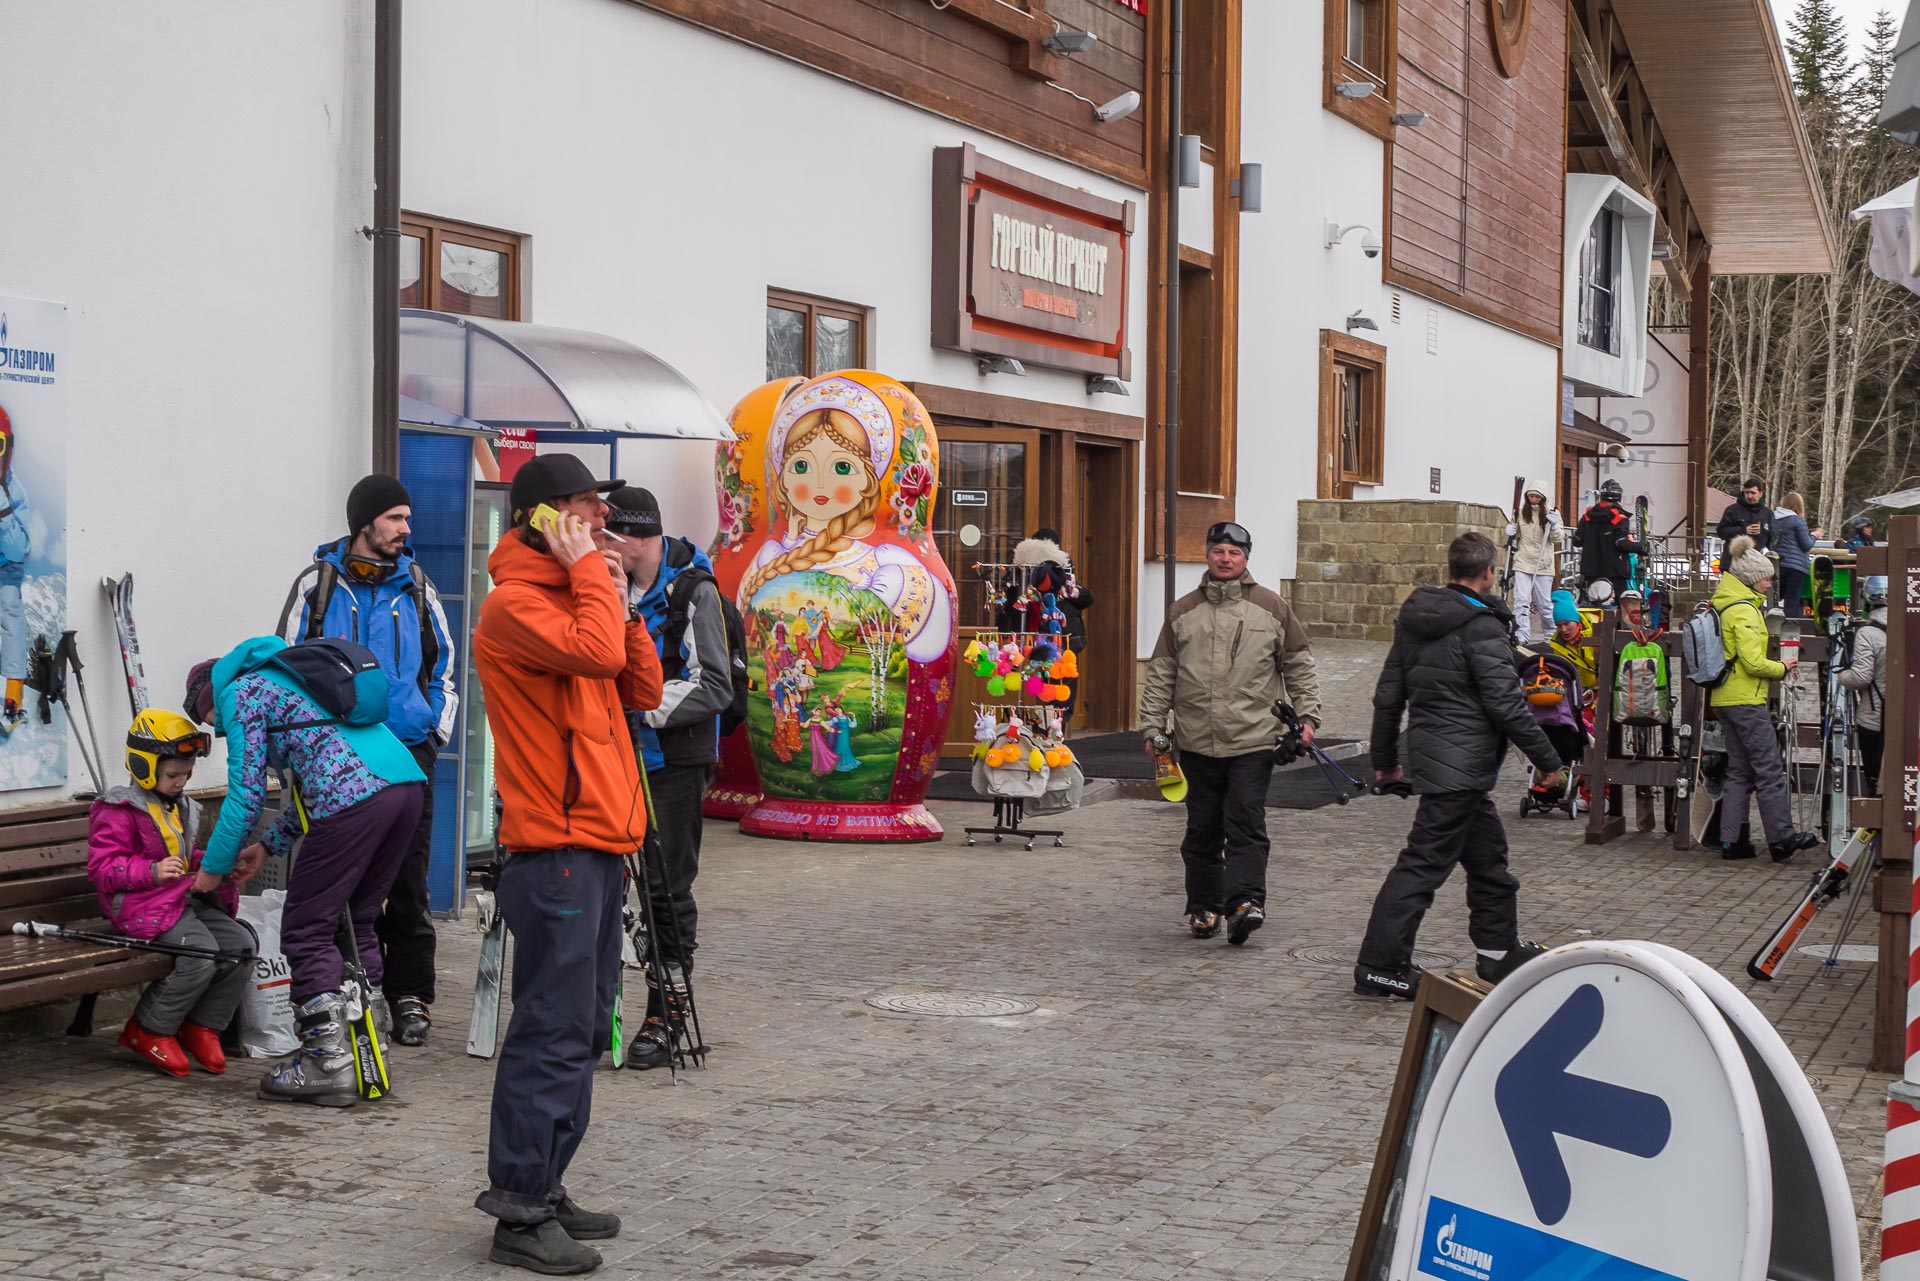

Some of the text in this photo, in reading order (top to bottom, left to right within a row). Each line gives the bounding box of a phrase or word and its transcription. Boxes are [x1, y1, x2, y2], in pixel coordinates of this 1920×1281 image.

[990, 212, 1108, 297] ГОРНЫЙ ПРИЮТ
[9, 348, 55, 372] ГАЗПРОМ
[494, 437, 518, 450] выбери
[816, 815, 839, 827] ИЗ
[845, 815, 897, 828] ВЯТКИ
[256, 957, 287, 980] Ski
[1366, 973, 1410, 990] HEAD
[1451, 1242, 1494, 1272] ГАЗПРОМ
